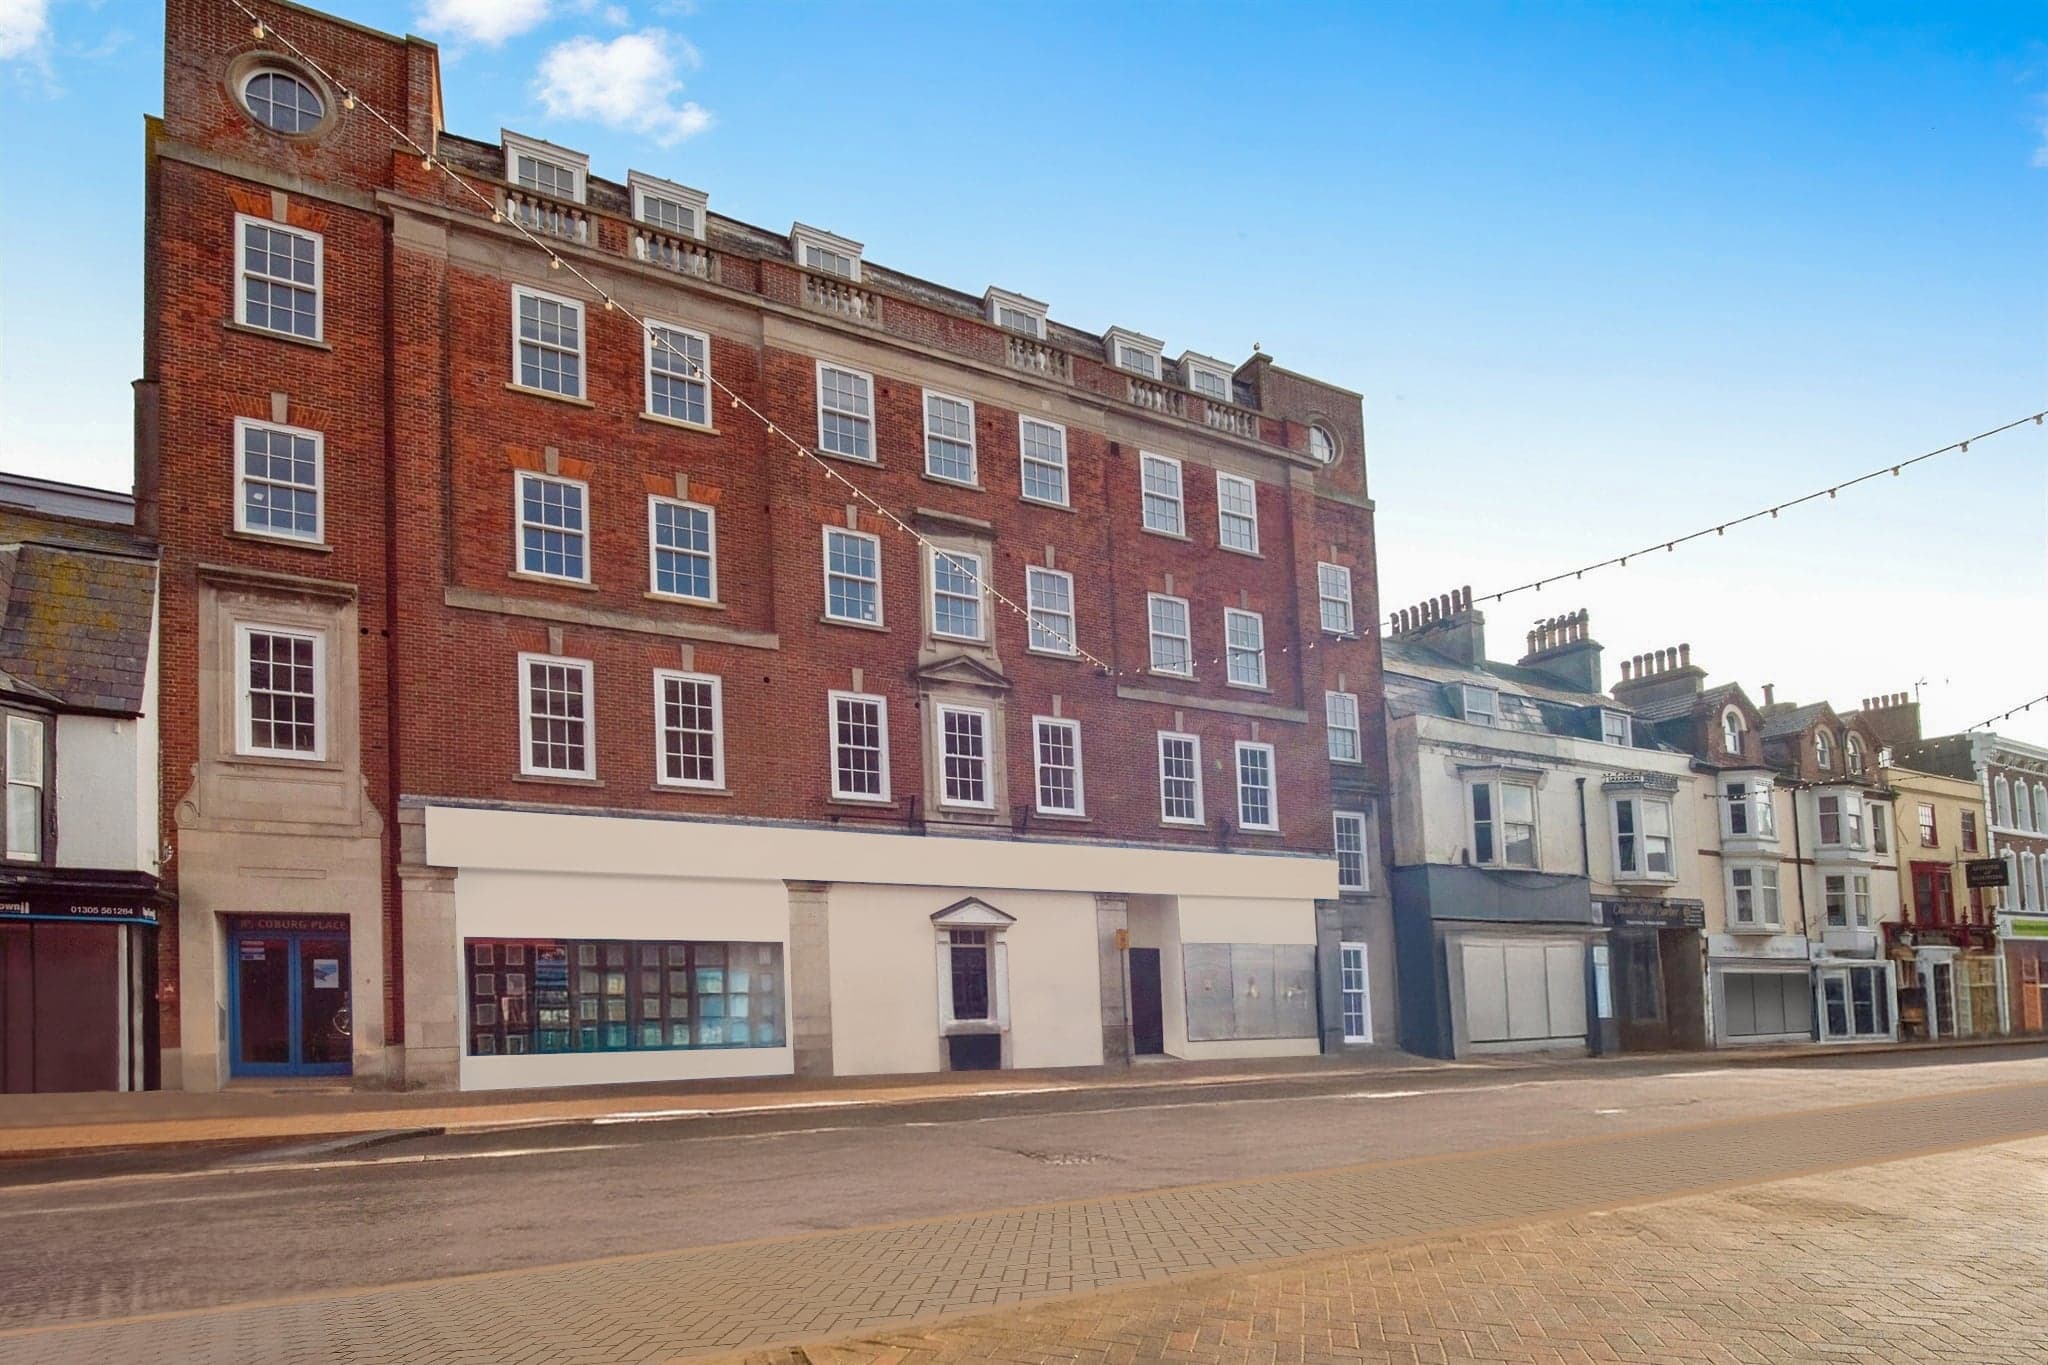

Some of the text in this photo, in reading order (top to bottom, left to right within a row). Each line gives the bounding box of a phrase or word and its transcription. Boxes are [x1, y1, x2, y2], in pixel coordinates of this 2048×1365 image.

[70, 905, 99, 914] 01305
[257, 919, 306, 929] COBURG
[310, 920, 348, 929] PLACE
